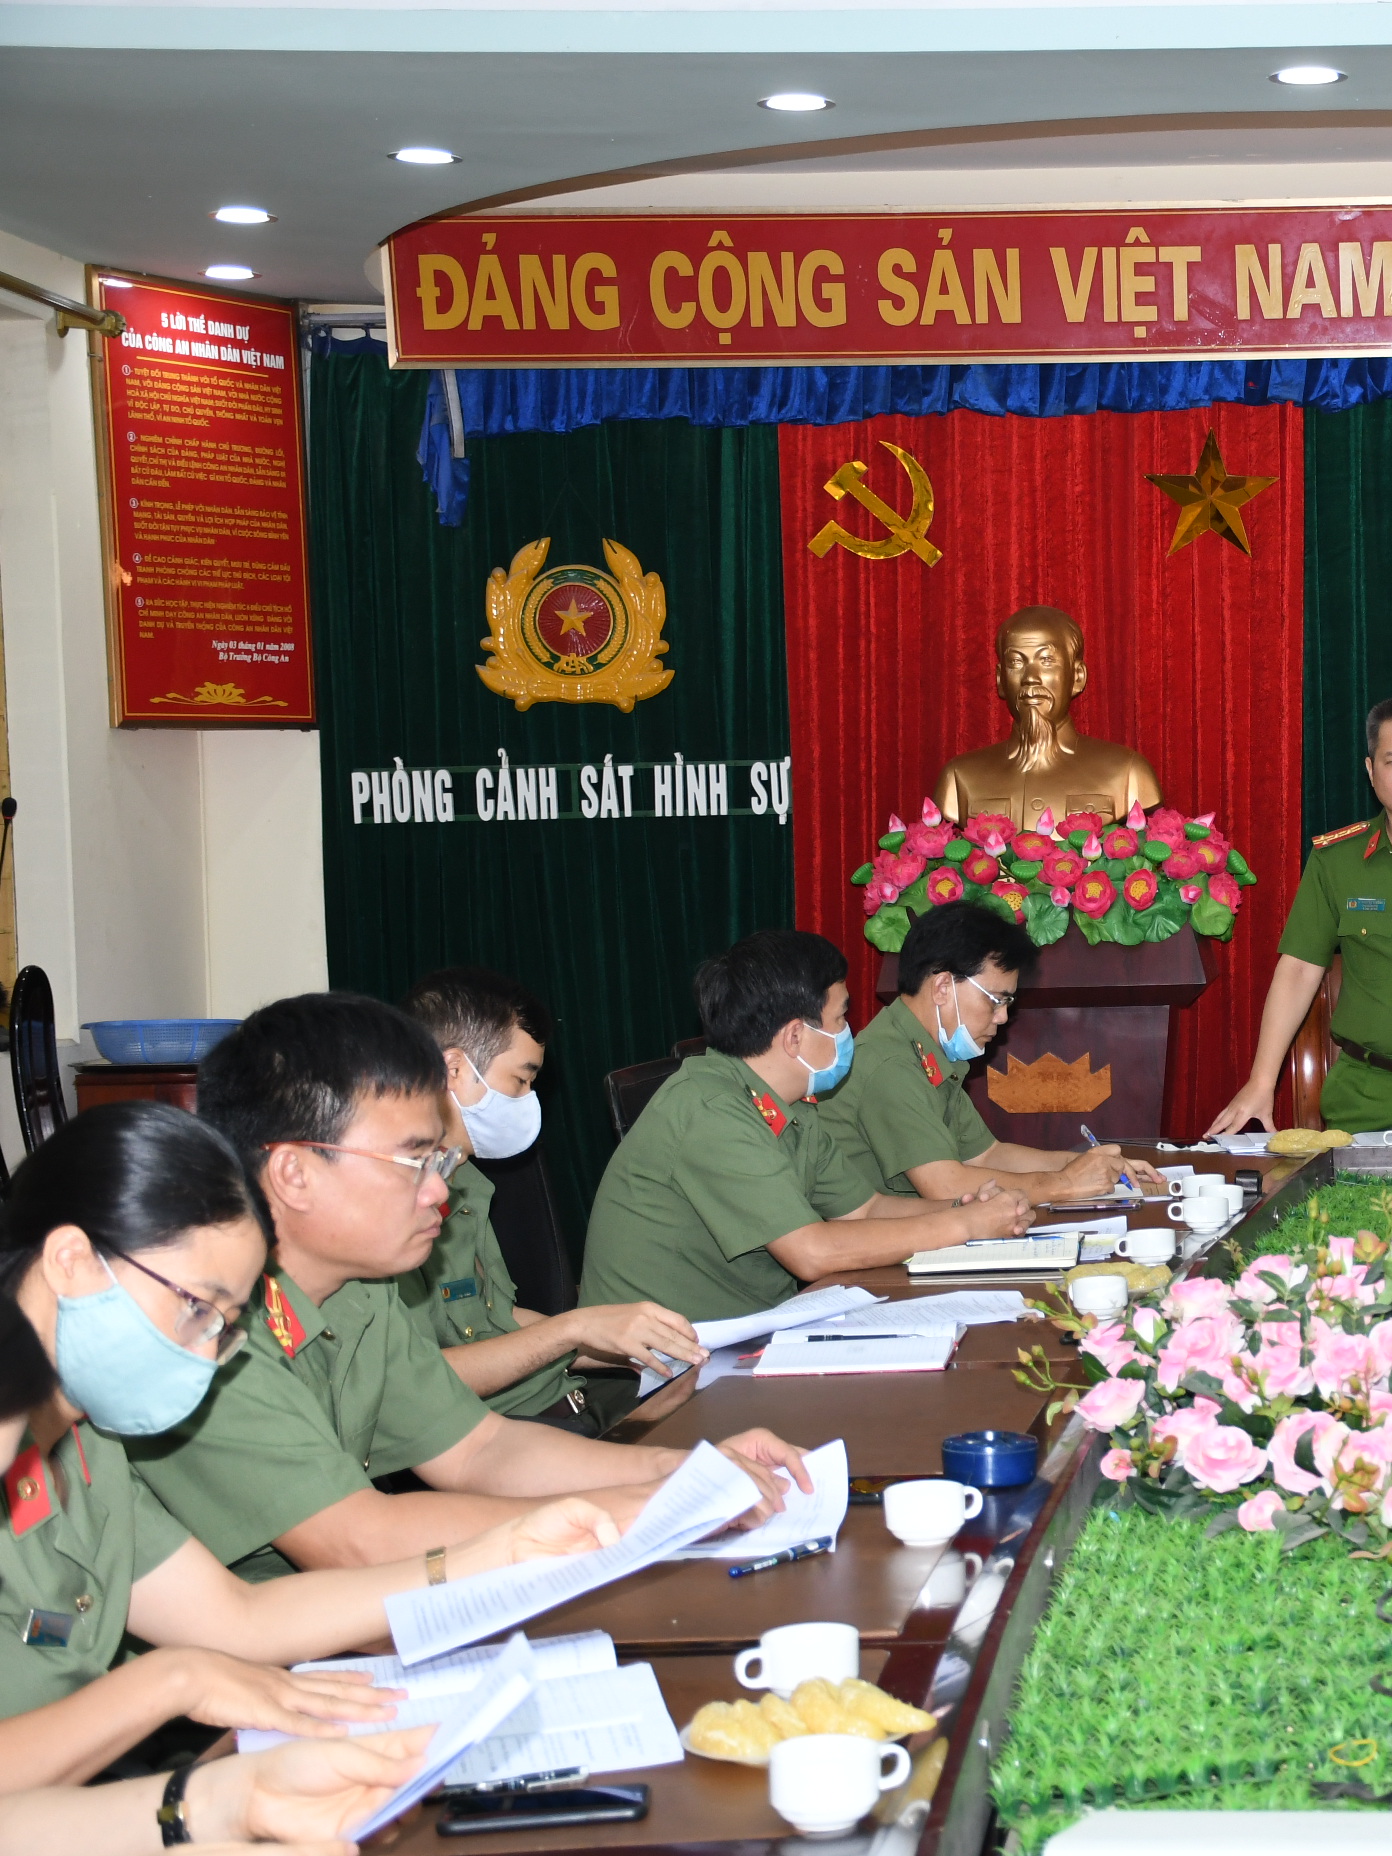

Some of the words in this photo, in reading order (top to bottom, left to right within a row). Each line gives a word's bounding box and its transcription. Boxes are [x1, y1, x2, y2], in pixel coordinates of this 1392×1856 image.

[417, 234, 619, 330] ĐẢNG
[650, 231, 846, 344] CỘNG
[878, 229, 1021, 326] SẢN
[1050, 227, 1201, 338] VIỆT
[161, 312, 169, 328] 5
[169, 311, 187, 331] LỜI
[207, 320, 234, 338] DANH
[235, 325, 250, 344] DỰ
[121, 327, 143, 349] CỦA
[144, 332, 174, 353] CÔNG
[175, 339, 190, 355] AN
[190, 340, 219, 360] NHÂN
[220, 344, 240, 363] DÂN
[241, 348, 261, 368] VIỆT
[263, 353, 284, 369] NAM
[212, 640, 228, 651] Ngày
[228, 640, 237, 649] 03
[256, 642, 264, 650] 01
[218, 651, 228, 662] Bộ
[252, 653, 262, 662] Bộ
[262, 653, 279, 664] Công
[280, 654, 289, 662] An
[352, 757, 453, 824] PHÒNG
[476, 748, 558, 821] CẢNH
[581, 754, 633, 818] SÁT
[654, 752, 727, 817] HÌNH
[751, 756, 790, 824] SỰ
